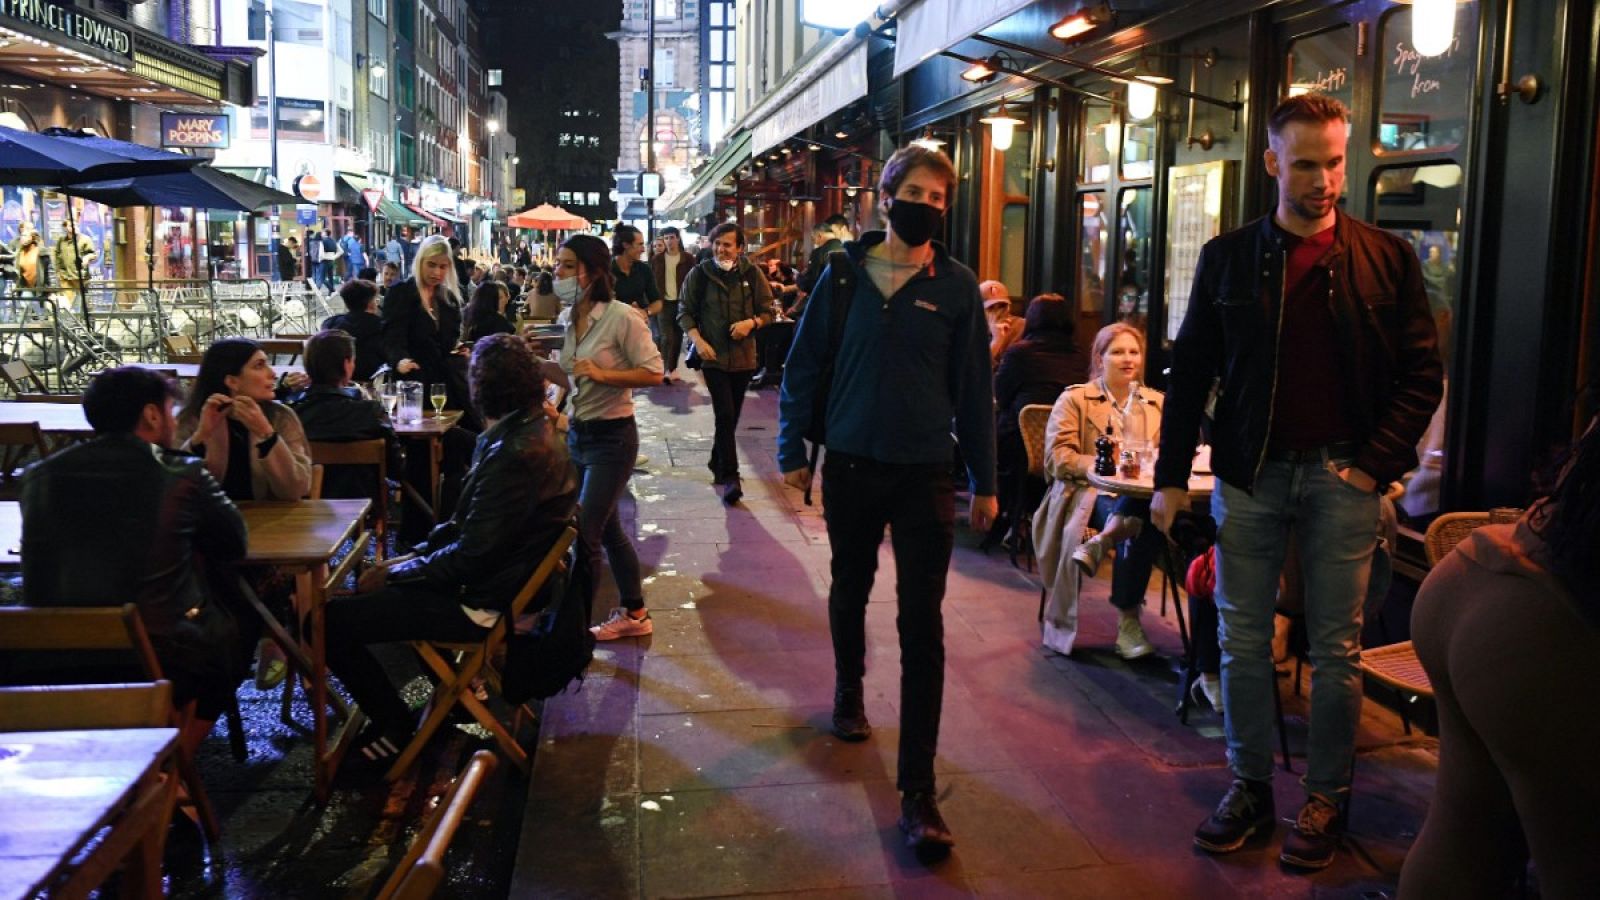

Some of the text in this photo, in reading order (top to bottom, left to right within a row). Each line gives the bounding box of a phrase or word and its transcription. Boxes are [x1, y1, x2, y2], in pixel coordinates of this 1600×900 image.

[11, 0, 129, 53] PRINCE EDWARD
[177, 119, 214, 131] MARY
[168, 129, 223, 143] POPPINS
